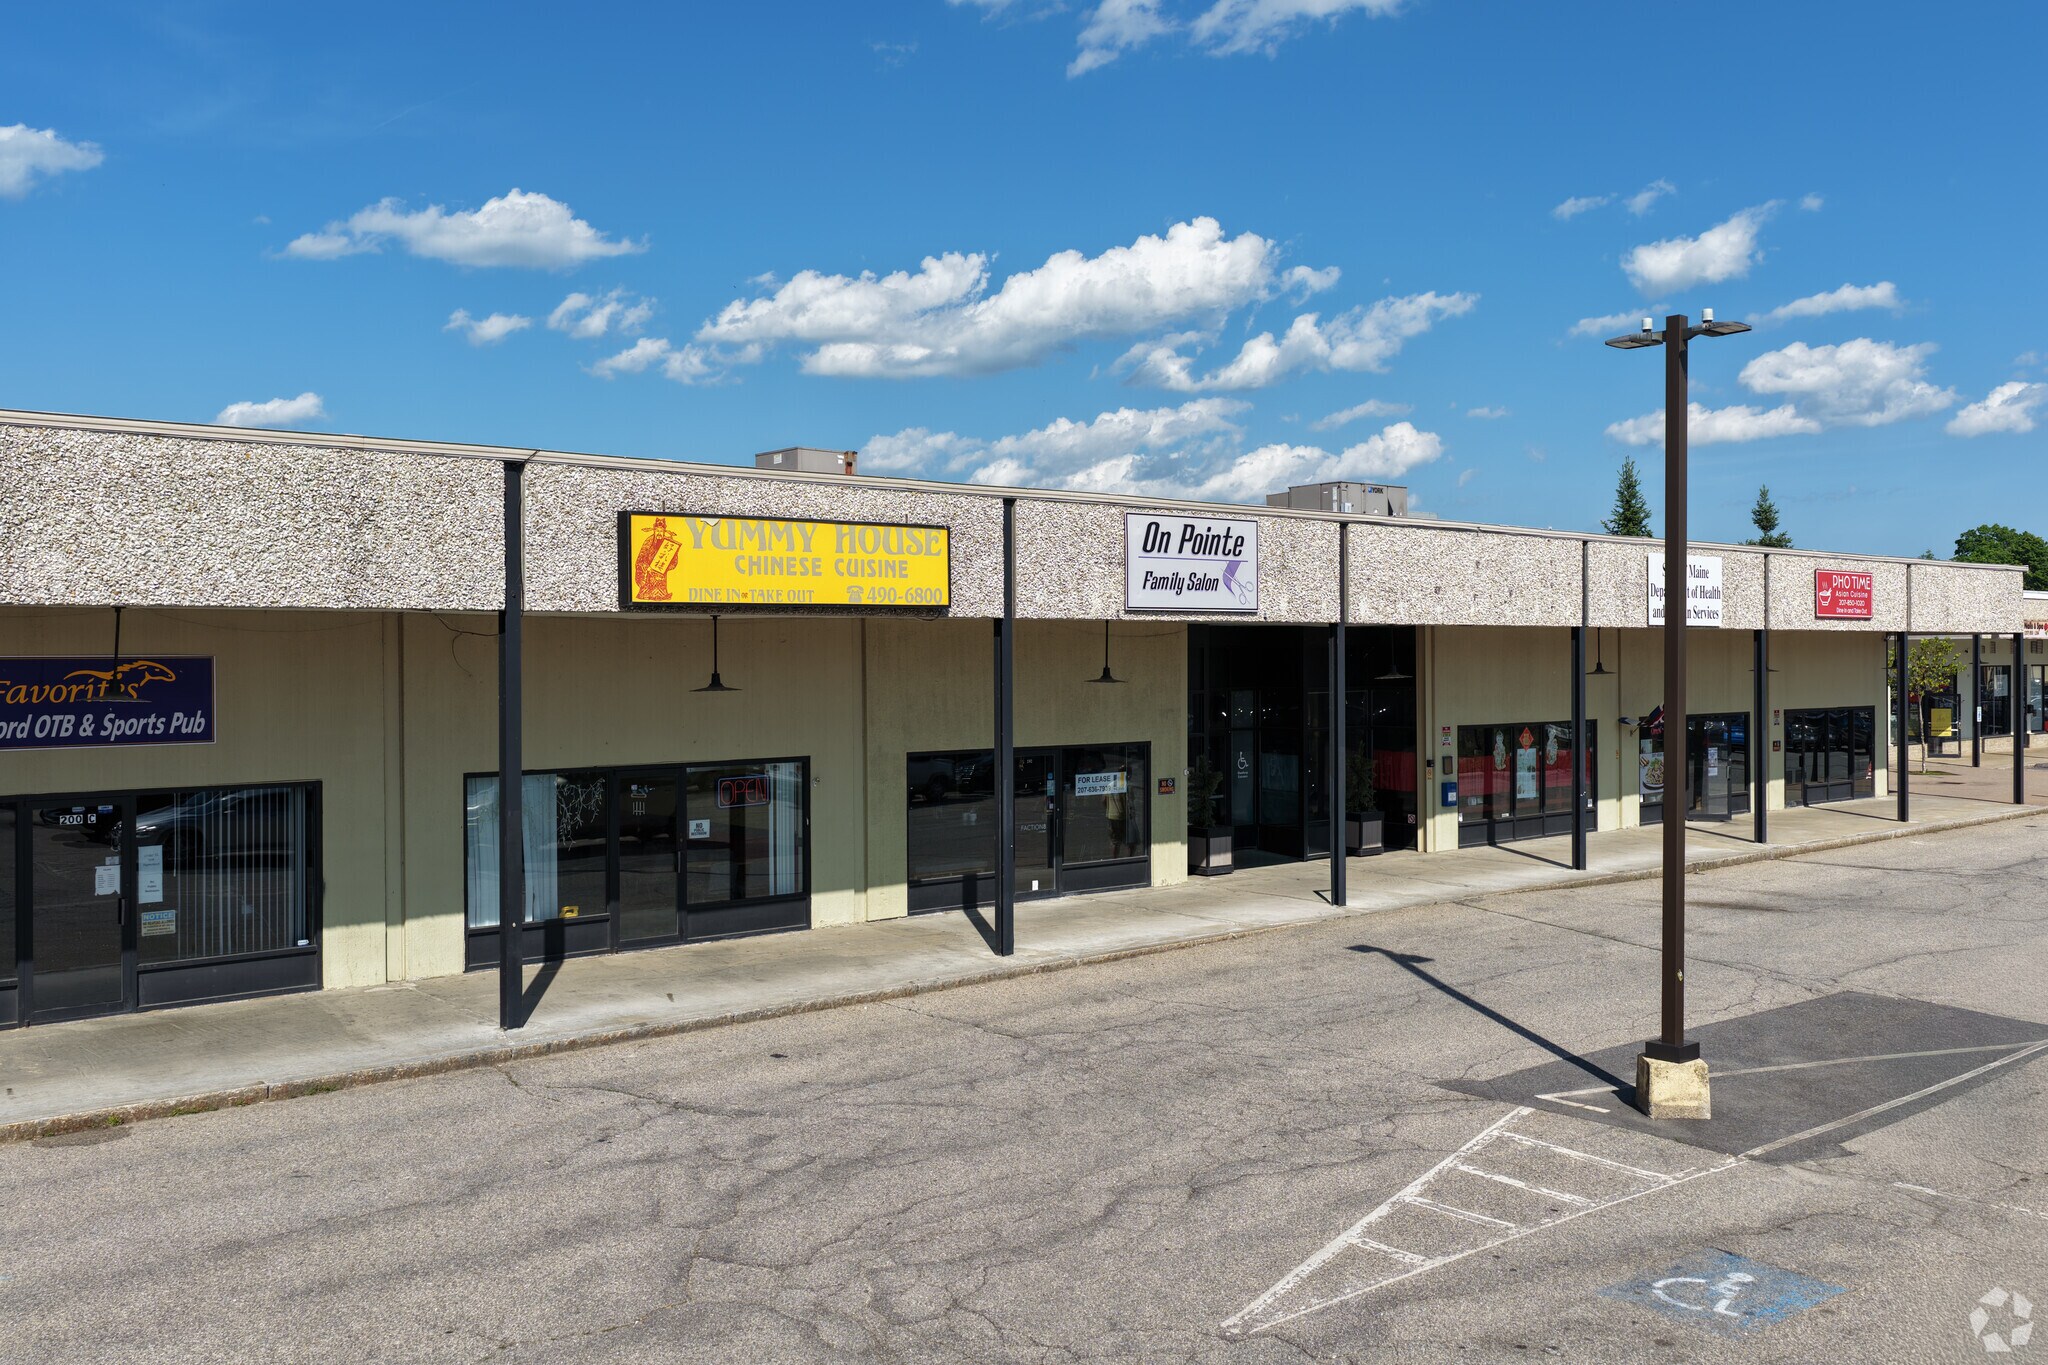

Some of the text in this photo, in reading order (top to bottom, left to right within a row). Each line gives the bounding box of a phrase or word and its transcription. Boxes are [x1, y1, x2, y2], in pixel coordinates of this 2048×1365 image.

[685, 518, 942, 557] YUMMY HOUSE
[1142, 521, 1245, 557] On Pointe
[735, 555, 909, 579] CHINESE CUISINE
[1689, 564, 1710, 579] Maine
[1142, 570, 1219, 596] Family Salon
[1832, 575, 1871, 590] PHO TIME
[688, 587, 724, 603] DINE
[727, 588, 741, 603] IN
[749, 588, 785, 603] TAKE
[787, 589, 815, 603] OUT
[867, 586, 943, 605] 490-6800
[1691, 585, 1698, 599] of
[1699, 585, 1721, 600] Health
[1835, 590, 1868, 599] Asian Cuisine
[1652, 605, 1666, 619] and
[1692, 605, 1719, 620] Services
[0, 677, 139, 705] Favorits
[34, 713, 76, 739] OTB
[79, 713, 96, 738] &
[100, 711, 166, 742] Sports
[169, 709, 206, 735] Pub
[1077, 776, 1091, 784] FOR
[1091, 775, 1111, 783] LEASE
[720, 779, 767, 804] OPEN
[60, 814, 96, 825] 200 C
[143, 911, 175, 920] NOTICE
